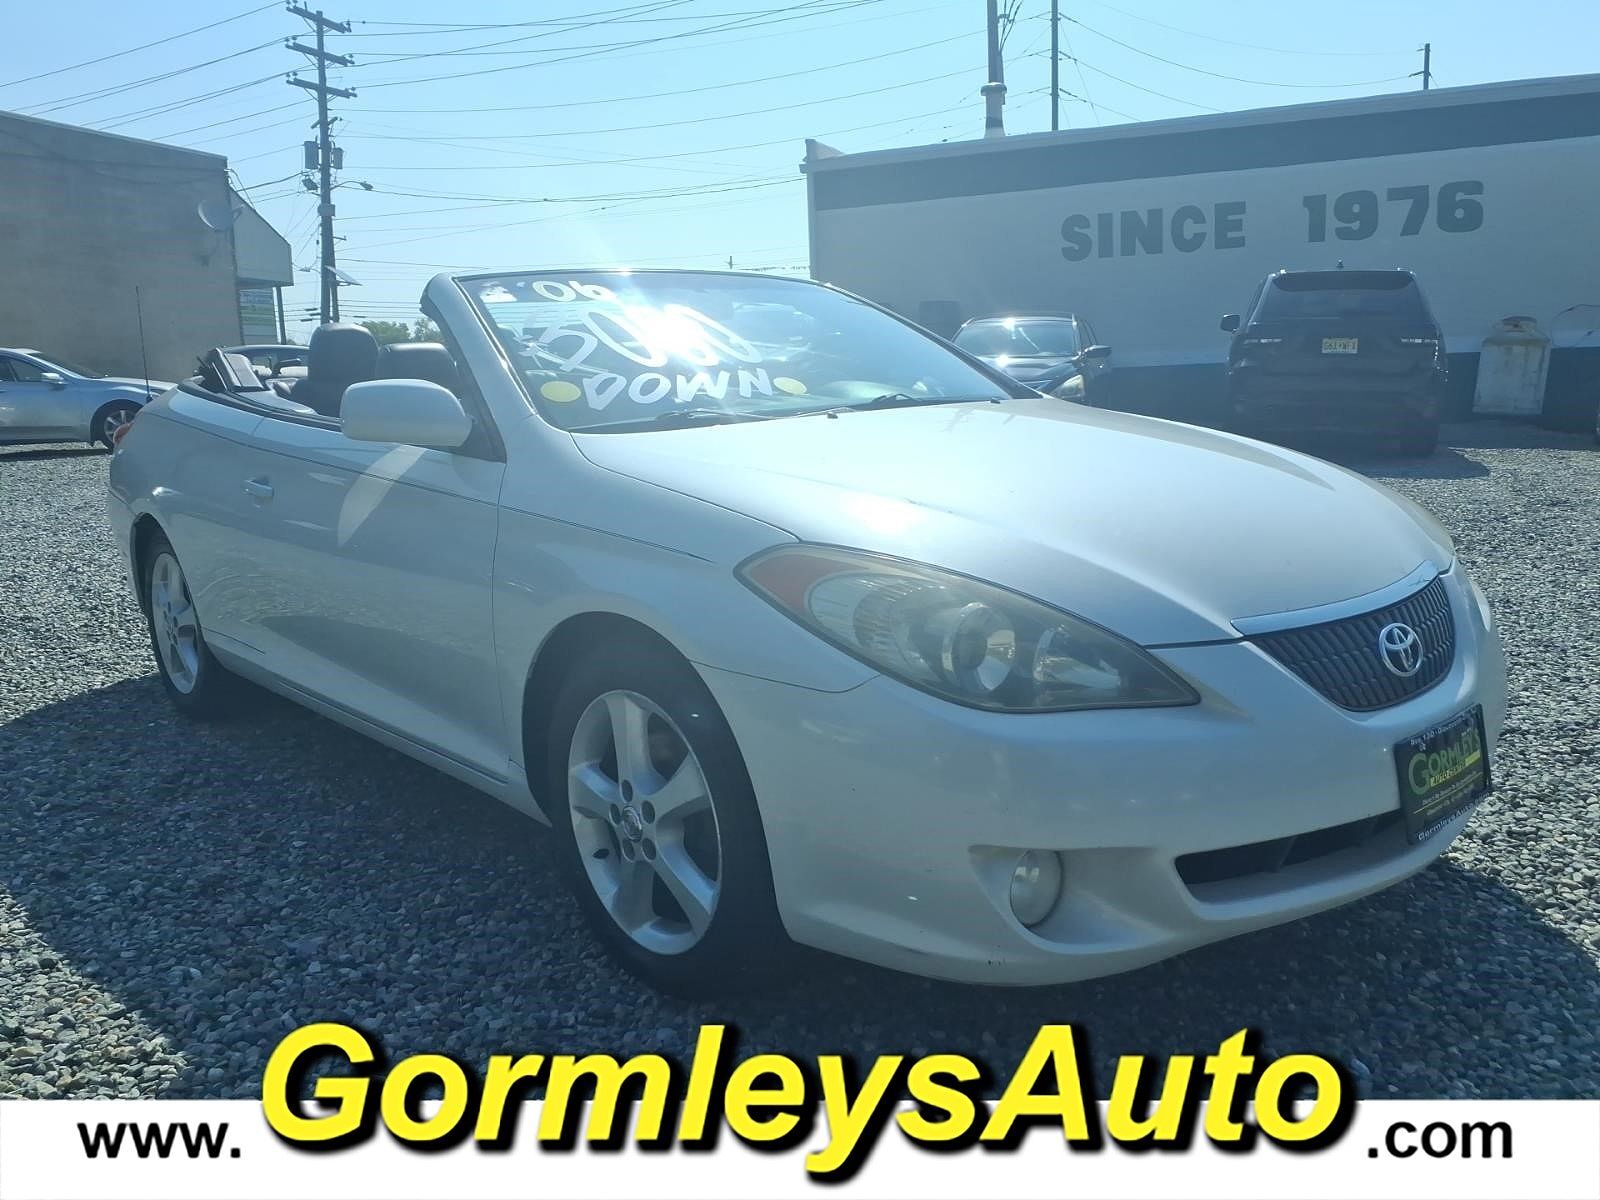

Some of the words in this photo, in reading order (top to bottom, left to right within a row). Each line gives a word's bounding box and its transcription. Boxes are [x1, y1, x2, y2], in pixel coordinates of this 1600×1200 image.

[1061, 200, 1246, 262] SINCE
[1303, 180, 1485, 243] 1976
[582, 366, 774, 411] DOWN
